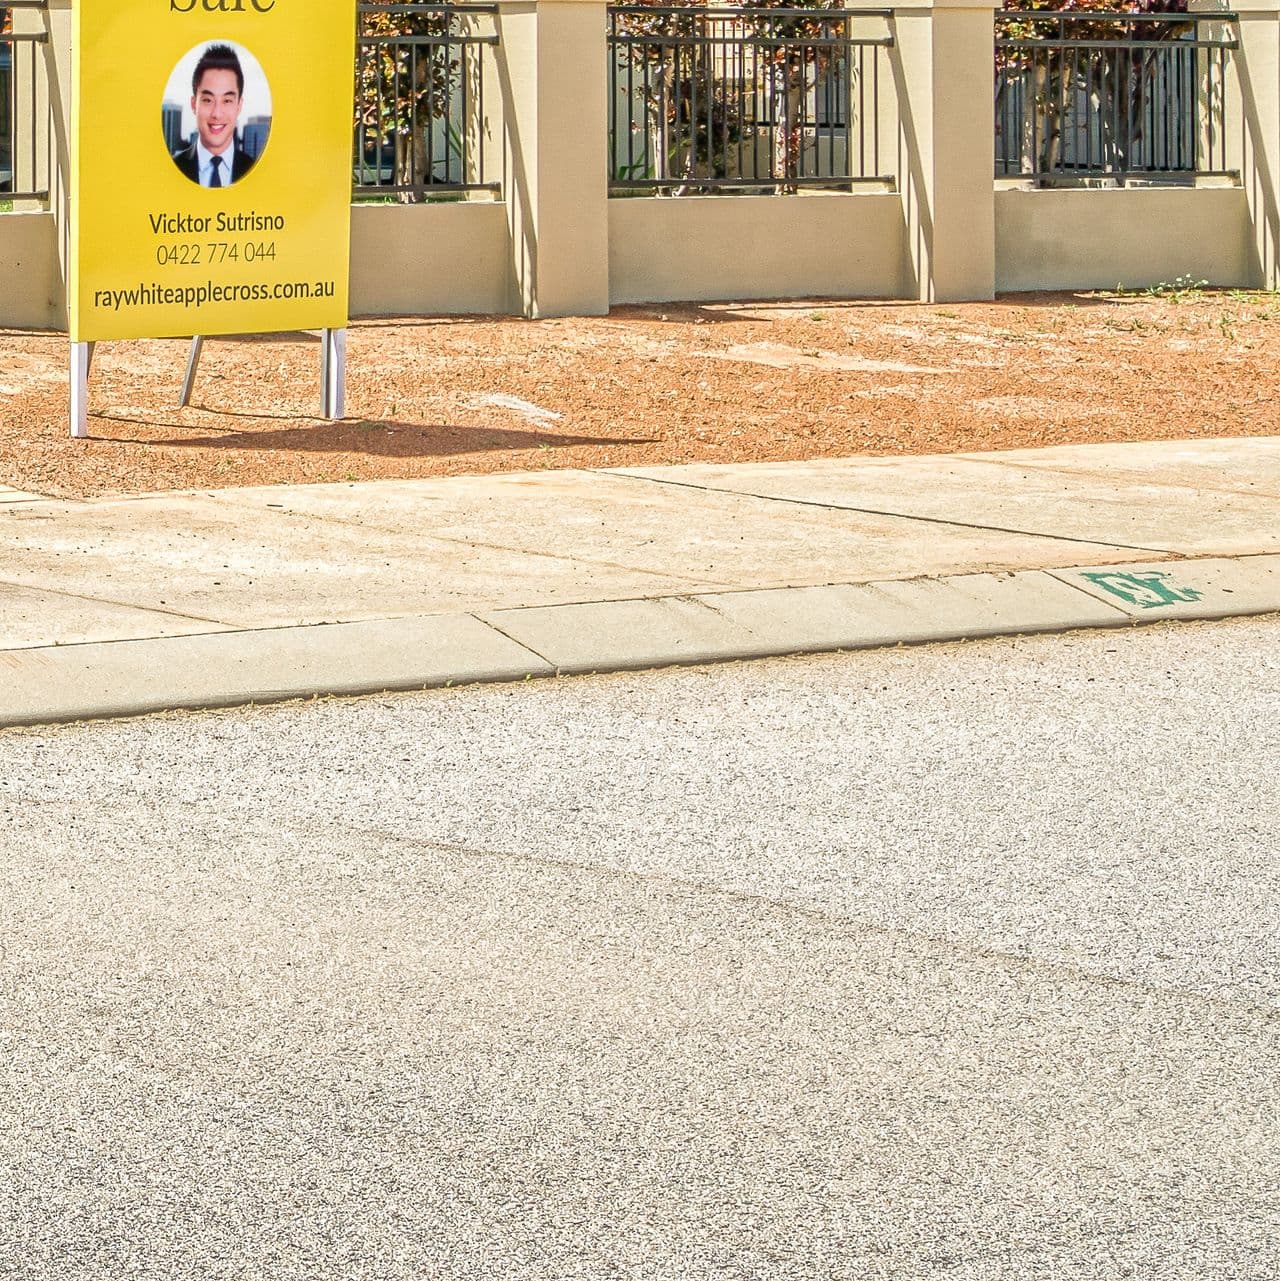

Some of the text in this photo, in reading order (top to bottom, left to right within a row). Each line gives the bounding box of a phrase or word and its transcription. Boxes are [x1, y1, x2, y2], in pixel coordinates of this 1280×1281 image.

[148, 210, 285, 234] Vicktor Sutrisno
[156, 241, 276, 266] 0422 774 044
[94, 280, 335, 311] raywhiteapplecross.com.au
